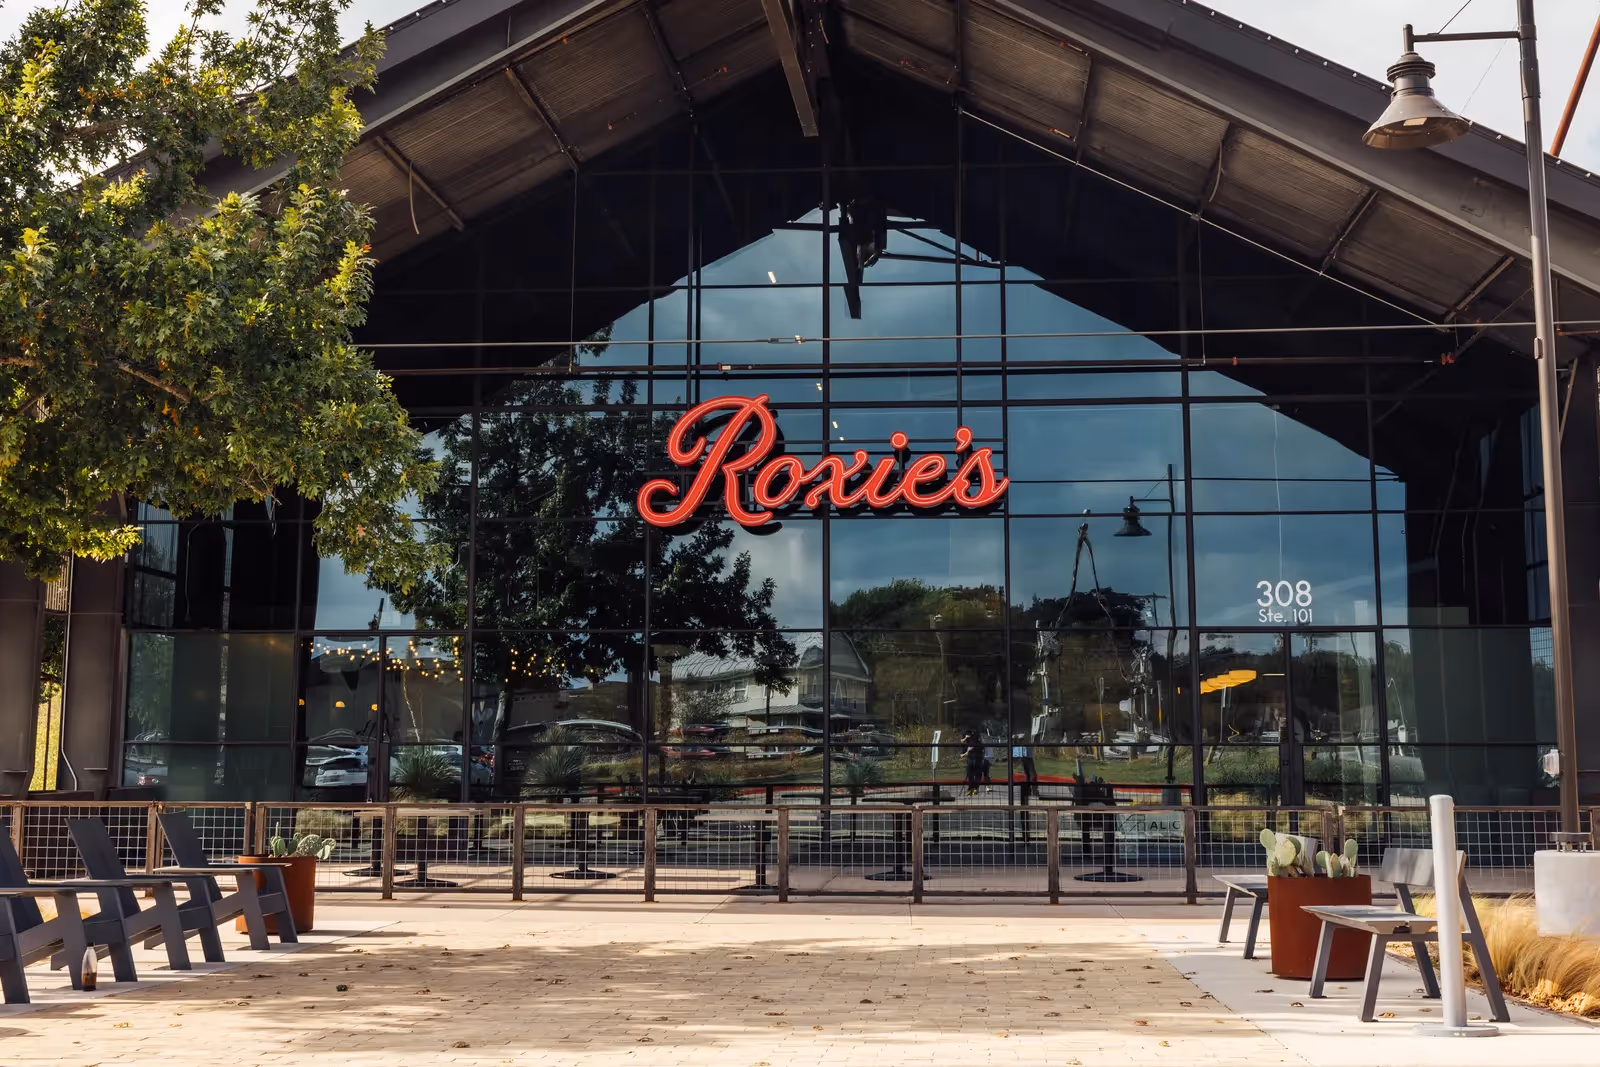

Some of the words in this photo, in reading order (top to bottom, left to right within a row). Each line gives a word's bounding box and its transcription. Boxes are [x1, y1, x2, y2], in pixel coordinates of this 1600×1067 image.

[637, 393, 1009, 527] Roxie's
[1256, 580, 1312, 607] 308
[1258, 608, 1287, 623] Ste.
[1293, 608, 1312, 623] 101
